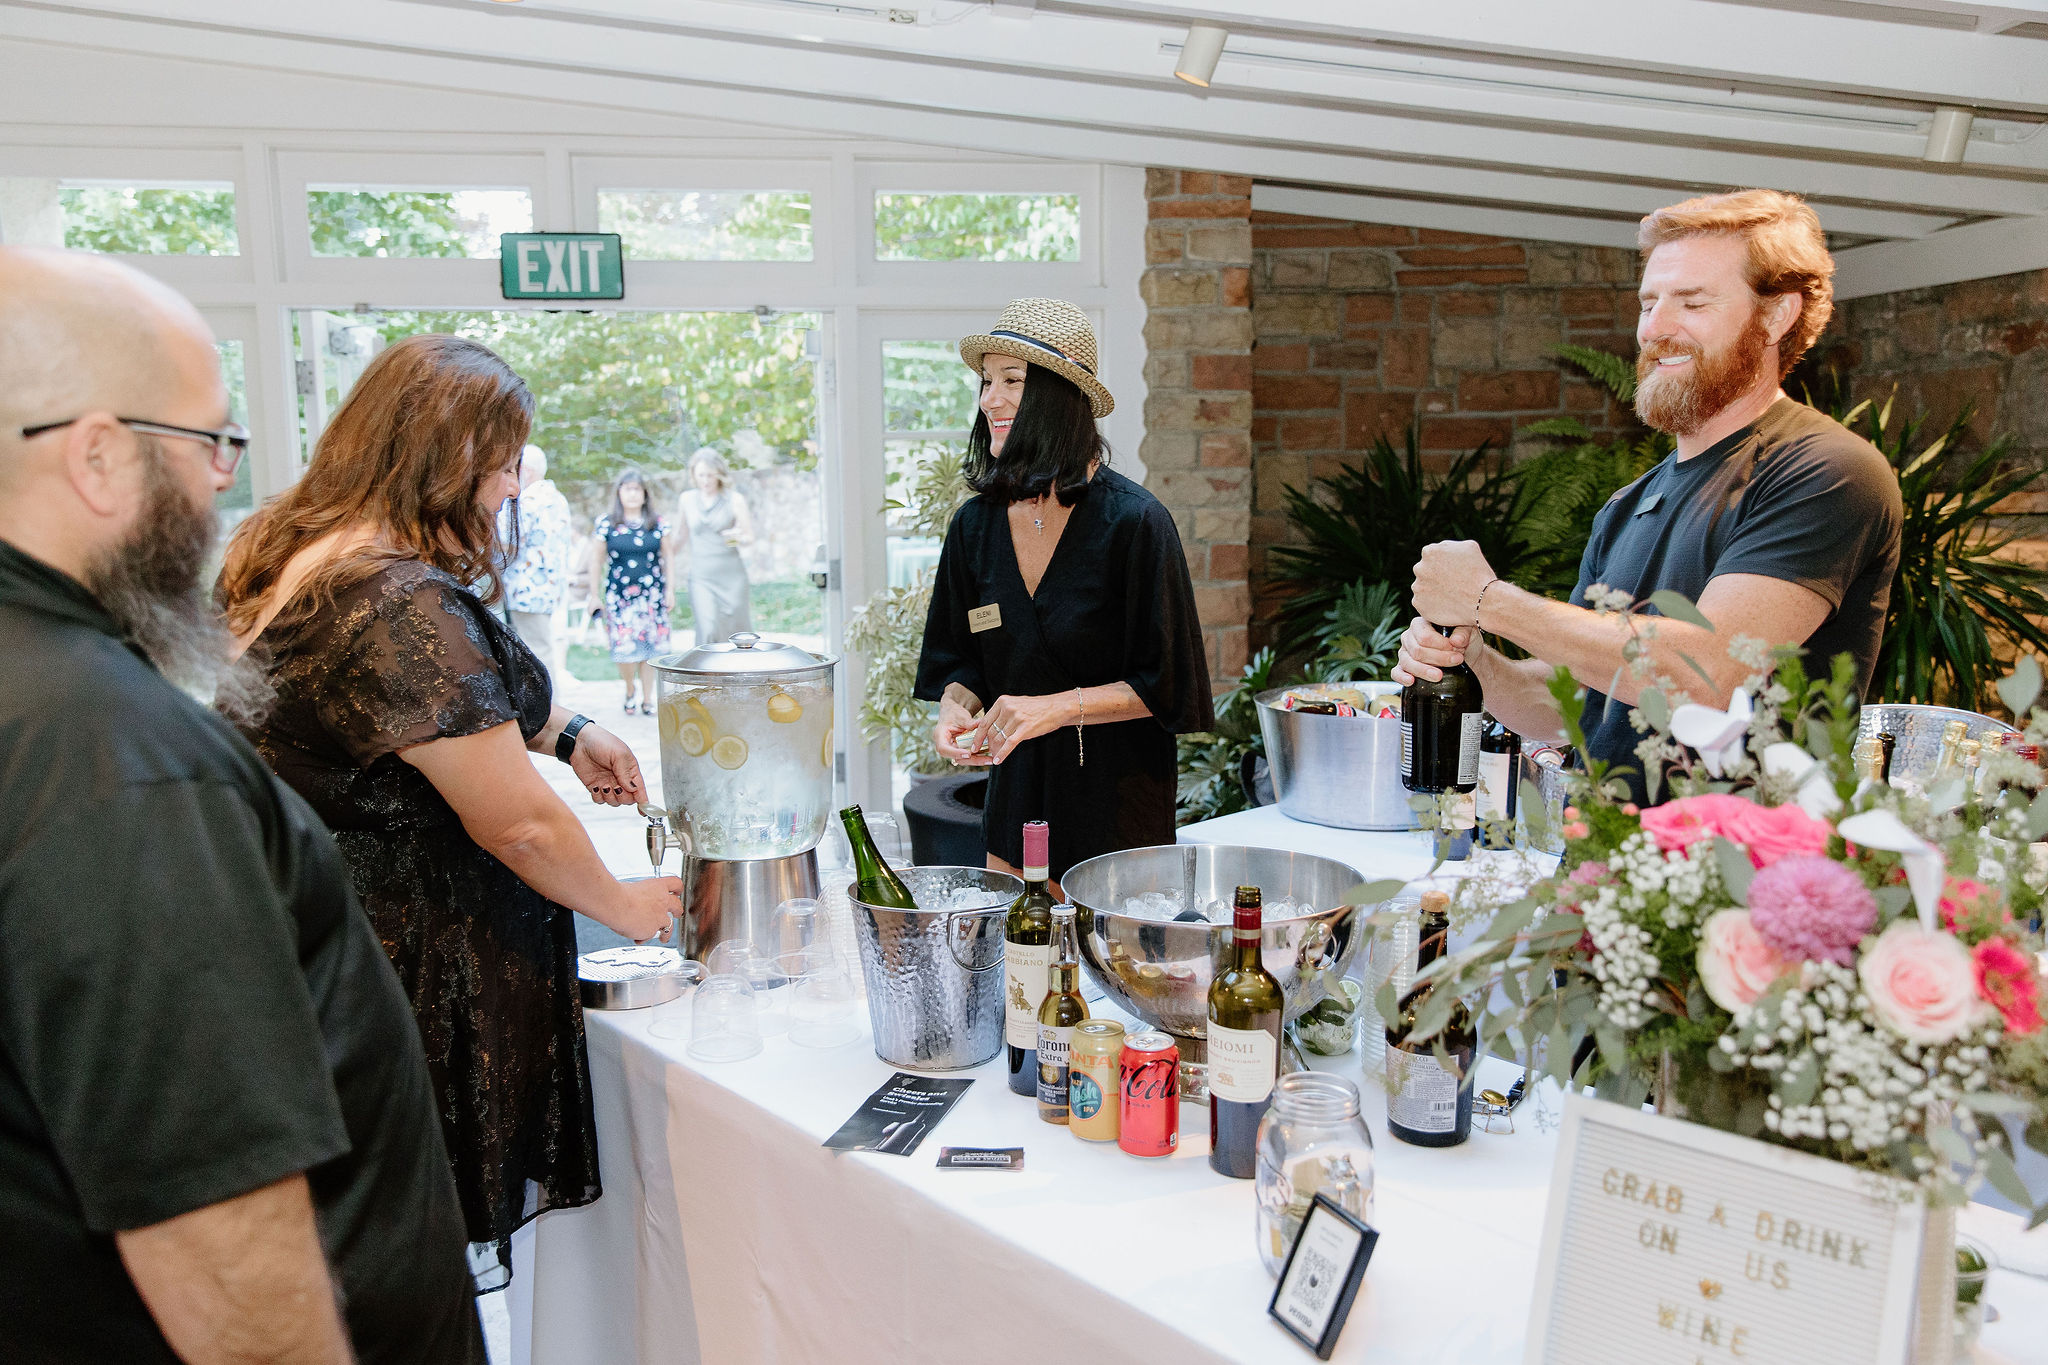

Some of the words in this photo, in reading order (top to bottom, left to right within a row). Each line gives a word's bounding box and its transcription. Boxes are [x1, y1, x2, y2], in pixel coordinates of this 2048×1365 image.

[516, 241, 605, 293] EXIT
[1005, 956, 1043, 967] ABBIANO
[1037, 1033, 1070, 1052] Coron
[1040, 1050, 1062, 1062] Extra
[892, 1087, 926, 1096] Cheers
[1602, 1167, 1684, 1214] GRAB
[1707, 1200, 1728, 1229] A
[1755, 1209, 1870, 1270] DRINK
[1638, 1217, 1679, 1256] ON
[1744, 1250, 1791, 1291] US
[1287, 1303, 1313, 1328] venmo
[1656, 1301, 1750, 1358] WINE
